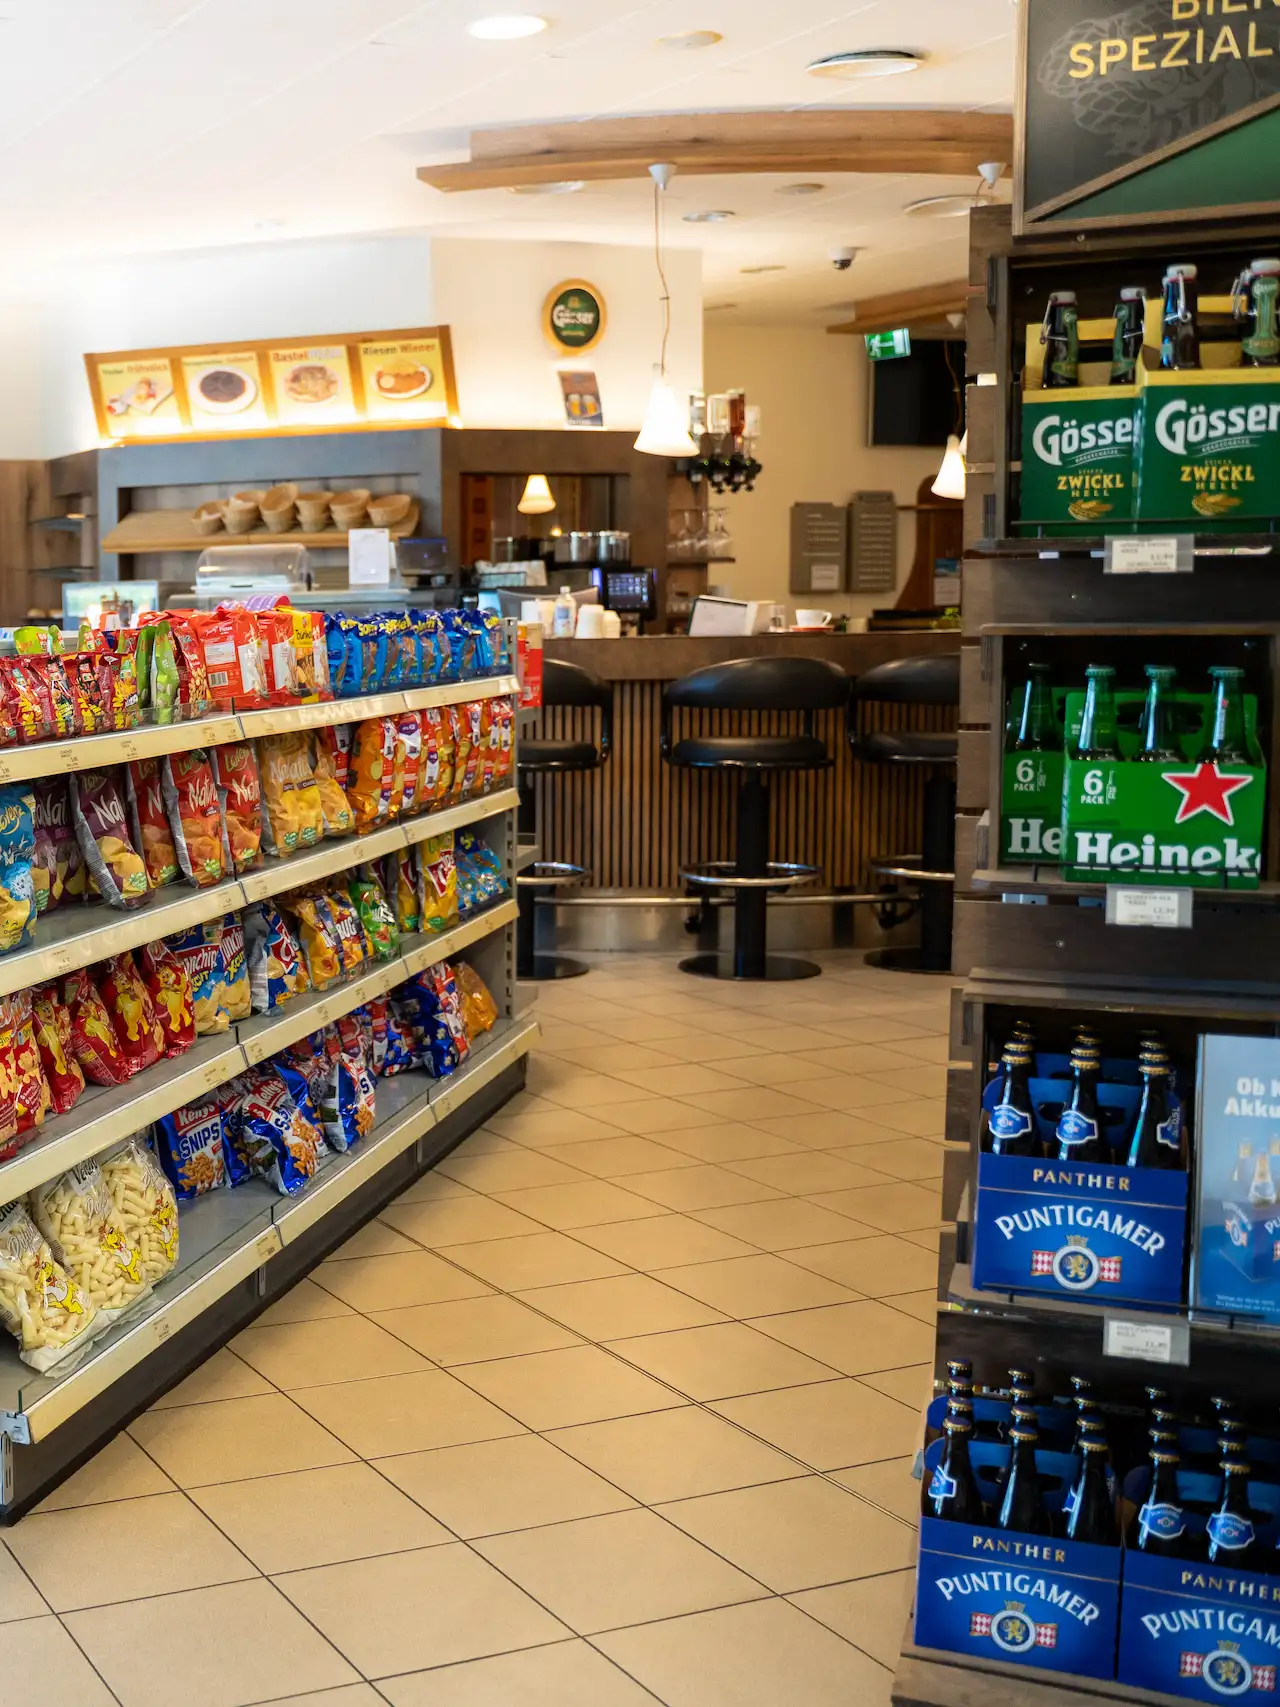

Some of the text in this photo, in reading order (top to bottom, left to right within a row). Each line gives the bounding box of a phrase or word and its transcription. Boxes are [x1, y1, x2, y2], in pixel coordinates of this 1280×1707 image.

[1057, 474, 1124, 490] ZWICKL
[1180, 464, 1255, 482] ZWICKL
[1071, 490, 1109, 498] HELL
[1195, 482, 1238, 490] HELL
[1015, 759, 1035, 783] 6
[1083, 769, 1104, 796] 6
[1013, 783, 1036, 792] PACK
[1080, 795, 1105, 805] PACK
[1074, 831, 1261, 877] Heinek
[1236, 1077, 1266, 1096] Ob
[179, 1120, 220, 1160] SNIPS
[1032, 1168, 1130, 1191] PANTHER
[994, 1204, 1166, 1257] PUNTIGAMER
[972, 1535, 1066, 1563] PANTHER
[1181, 1570, 1280, 1601] PANTHER
[935, 1570, 1101, 1627] PUNTIGAMER
